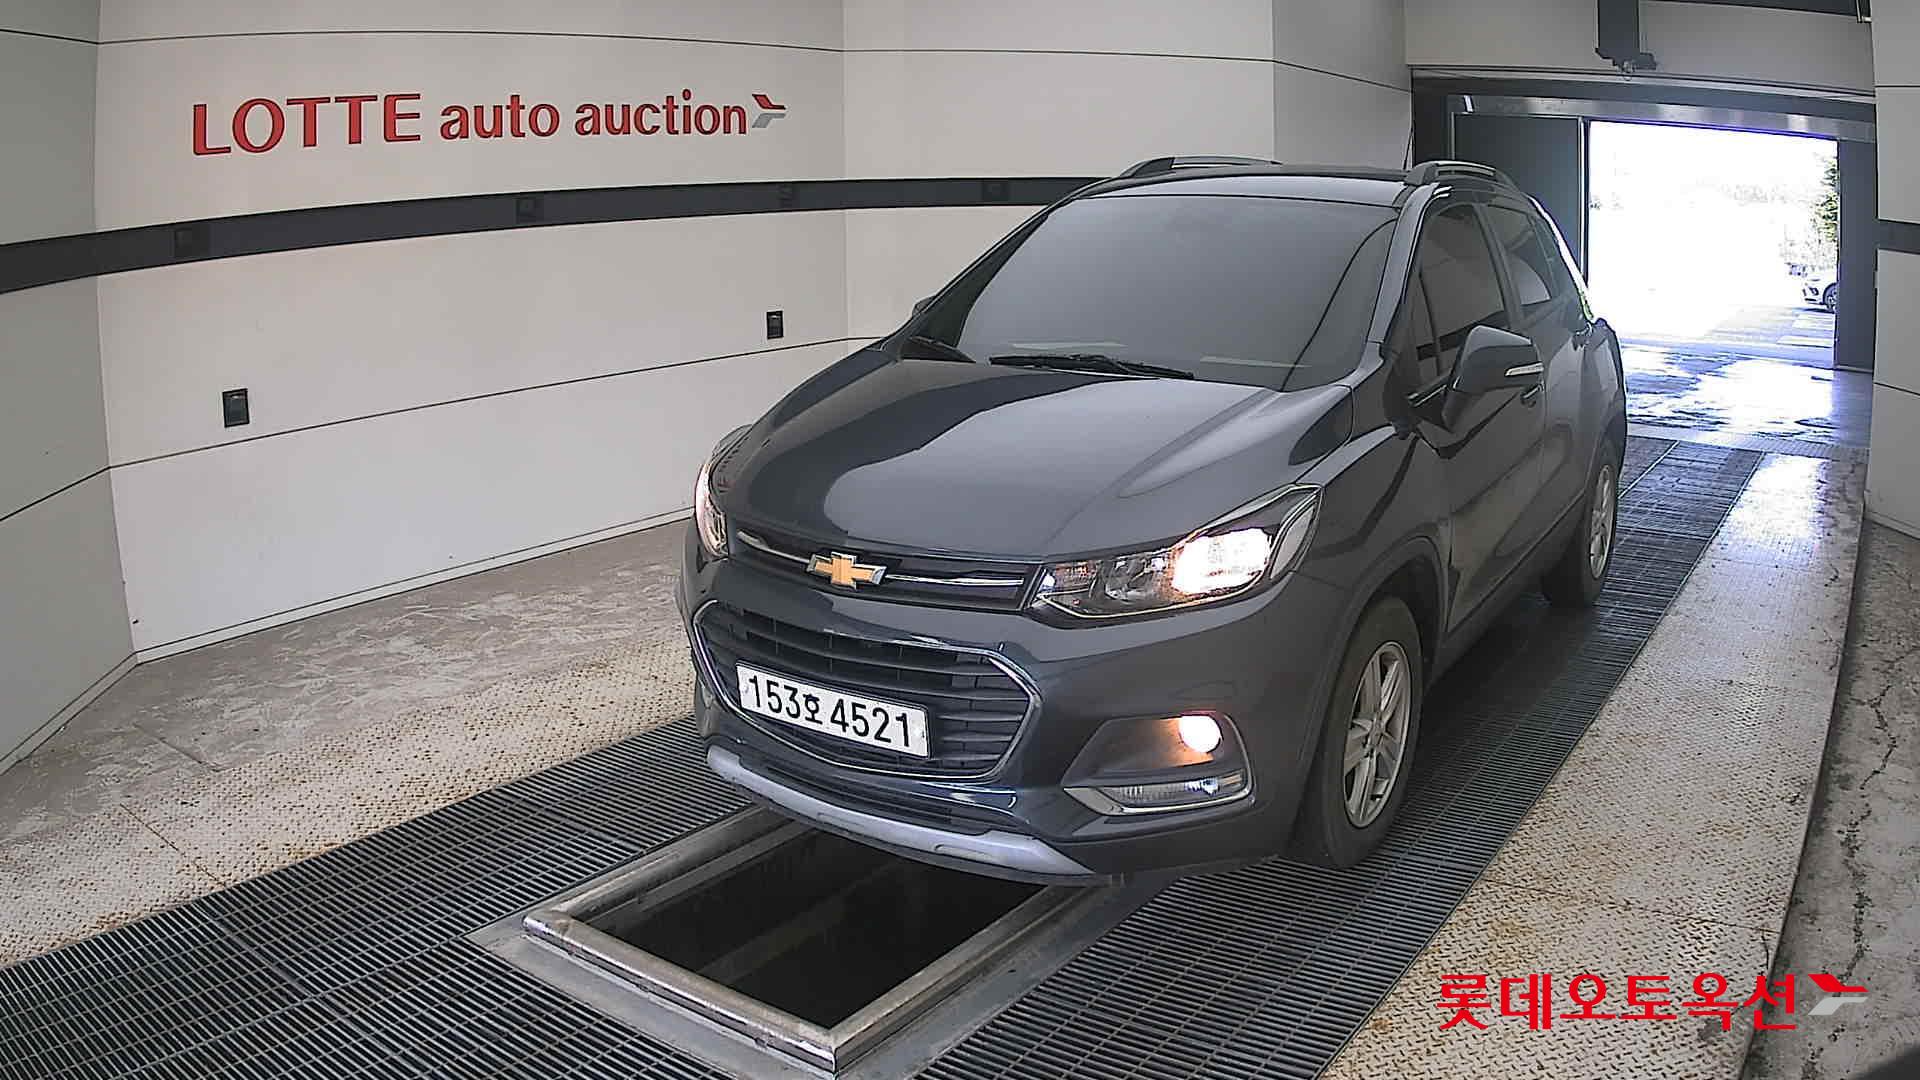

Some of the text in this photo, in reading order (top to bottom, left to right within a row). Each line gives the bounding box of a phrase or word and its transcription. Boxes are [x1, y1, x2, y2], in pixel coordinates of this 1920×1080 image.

[192, 89, 748, 156] LOTTE auto auction
[748, 674, 910, 748] 153호 4521
